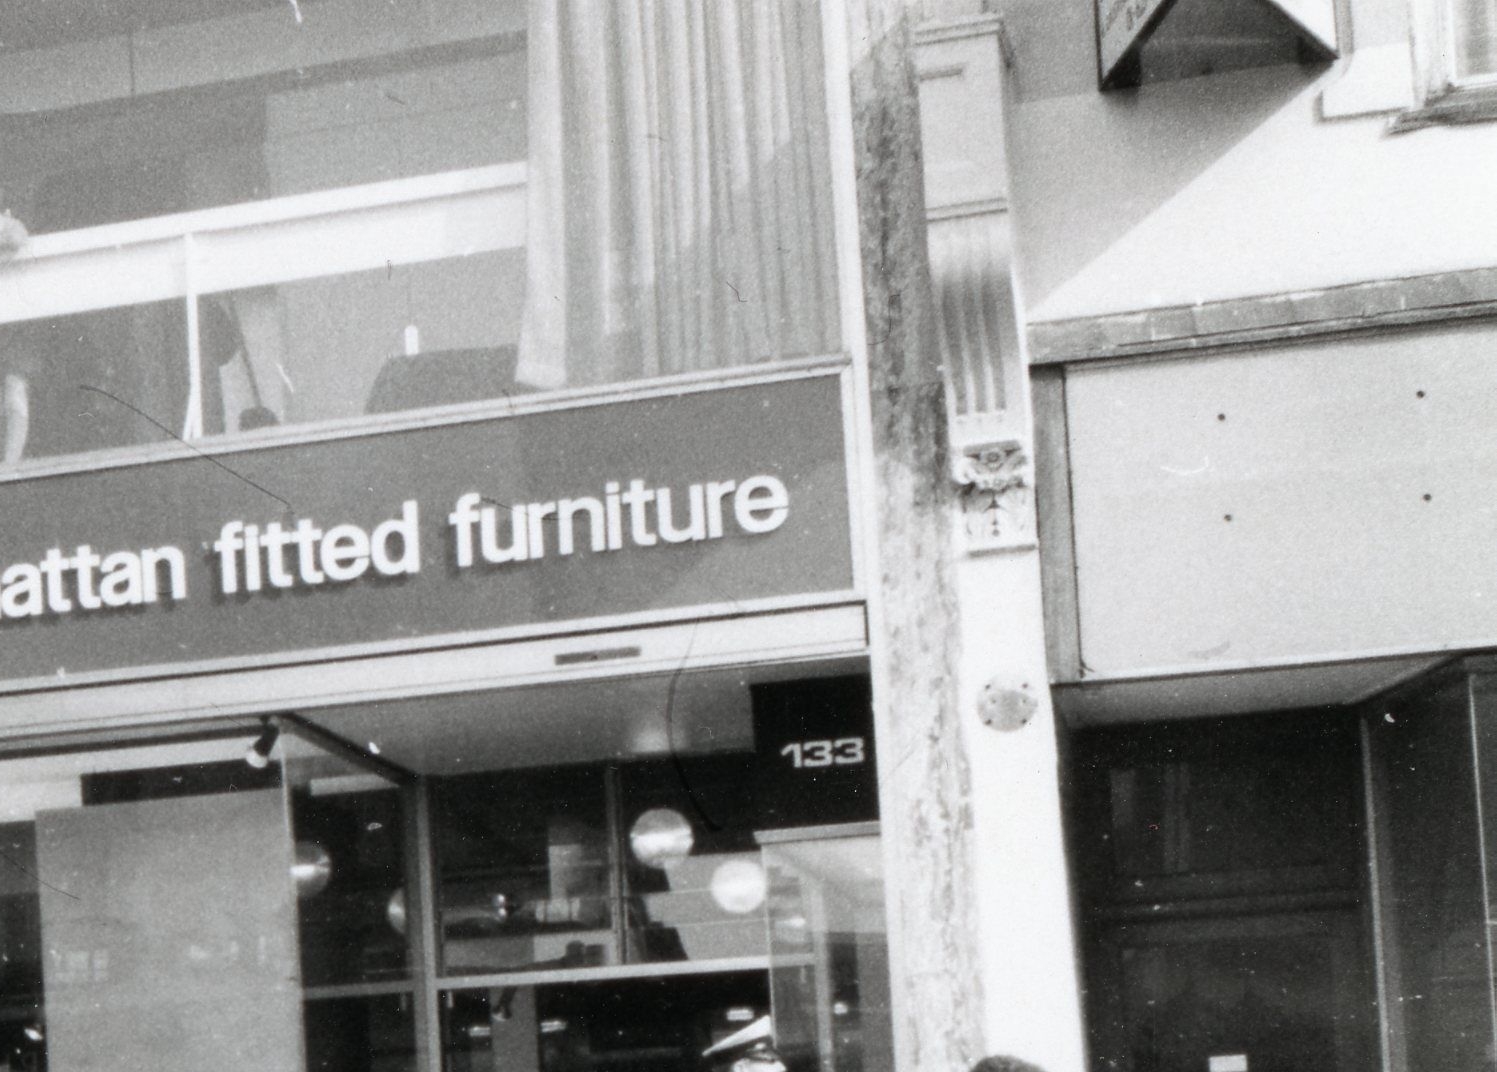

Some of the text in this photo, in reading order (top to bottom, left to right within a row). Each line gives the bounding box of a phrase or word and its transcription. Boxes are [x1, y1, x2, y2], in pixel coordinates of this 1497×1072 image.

[213, 500, 420, 594] fitted
[449, 475, 790, 568] furniture
[781, 737, 865, 768] 133
